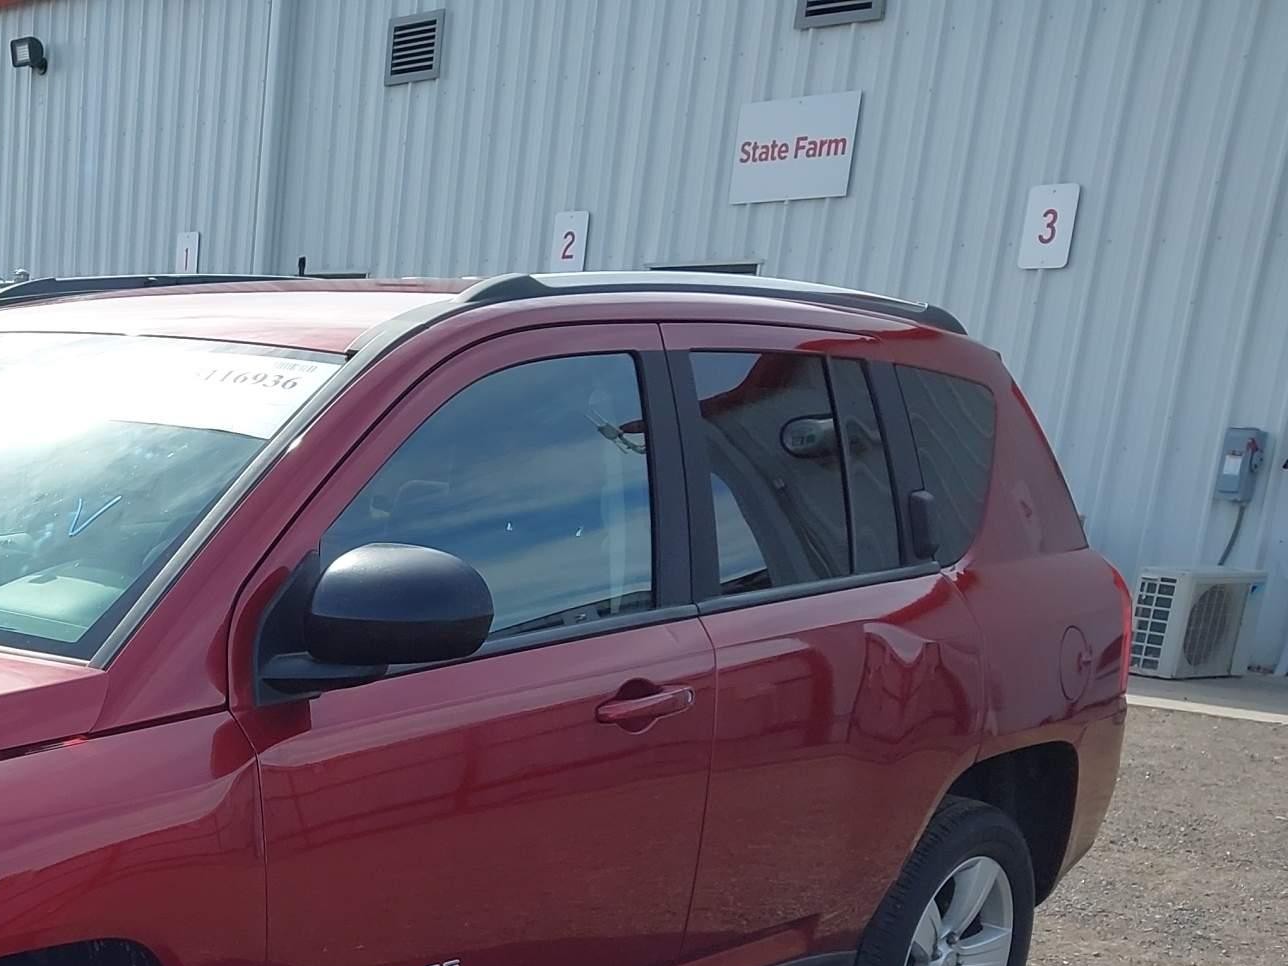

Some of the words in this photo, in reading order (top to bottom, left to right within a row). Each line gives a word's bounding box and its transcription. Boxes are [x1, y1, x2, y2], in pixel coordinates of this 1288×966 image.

[739, 139, 789, 164] State
[793, 136, 847, 159] Farm
[1038, 208, 1058, 245] 3
[561, 230, 576, 260] 2
[197, 368, 300, 391] 116936
